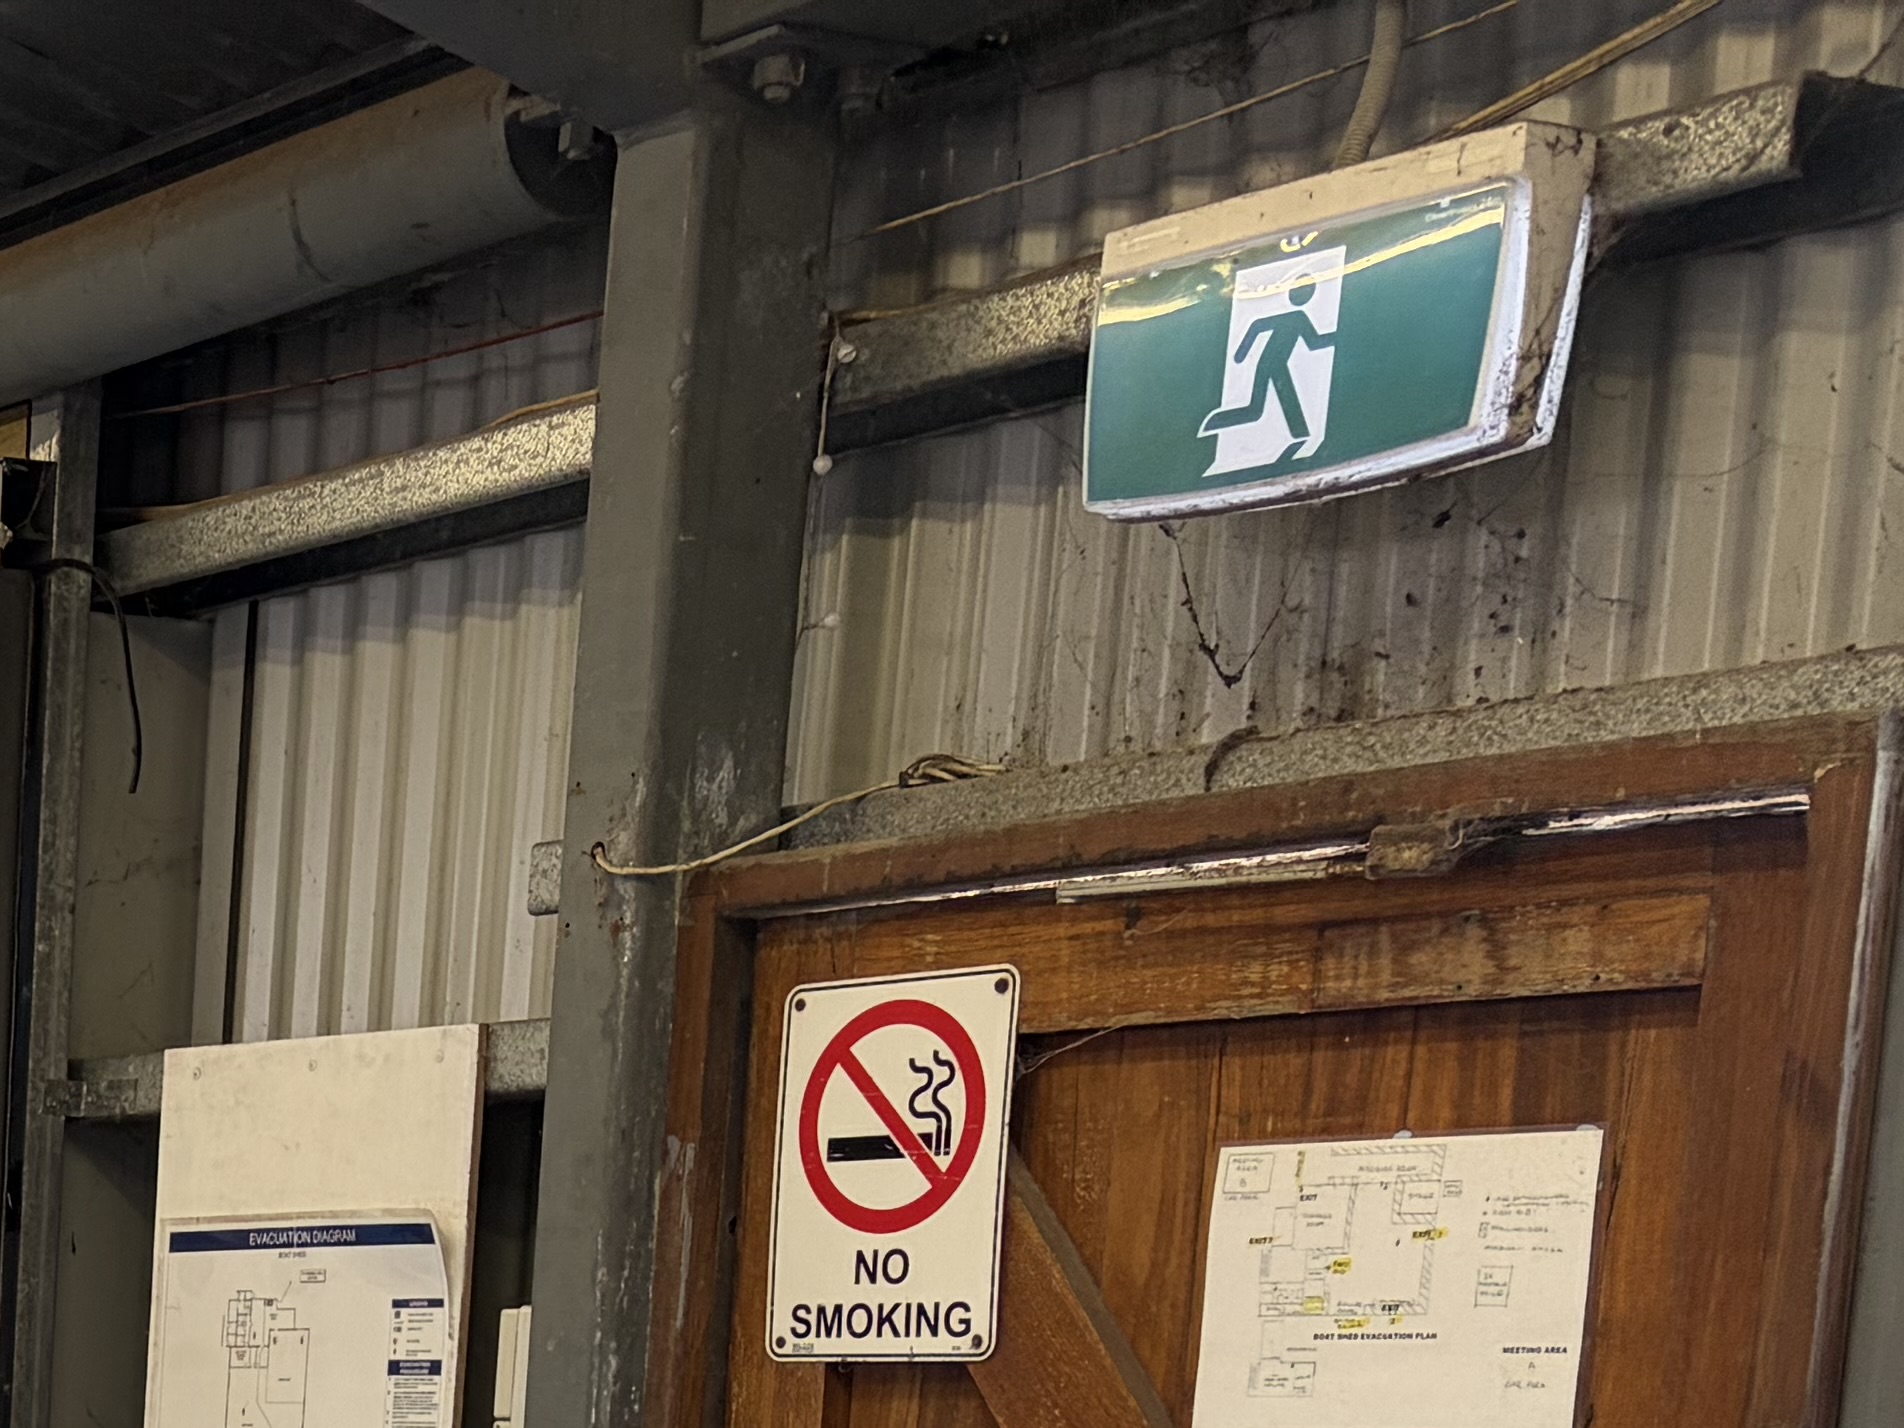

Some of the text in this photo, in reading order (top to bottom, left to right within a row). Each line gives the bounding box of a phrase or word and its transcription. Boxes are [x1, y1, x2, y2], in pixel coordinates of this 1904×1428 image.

[249, 1229, 356, 1247] EVACUATION DIAGRAM
[854, 1247, 910, 1285] NO
[790, 1301, 972, 1339] SMOKING
